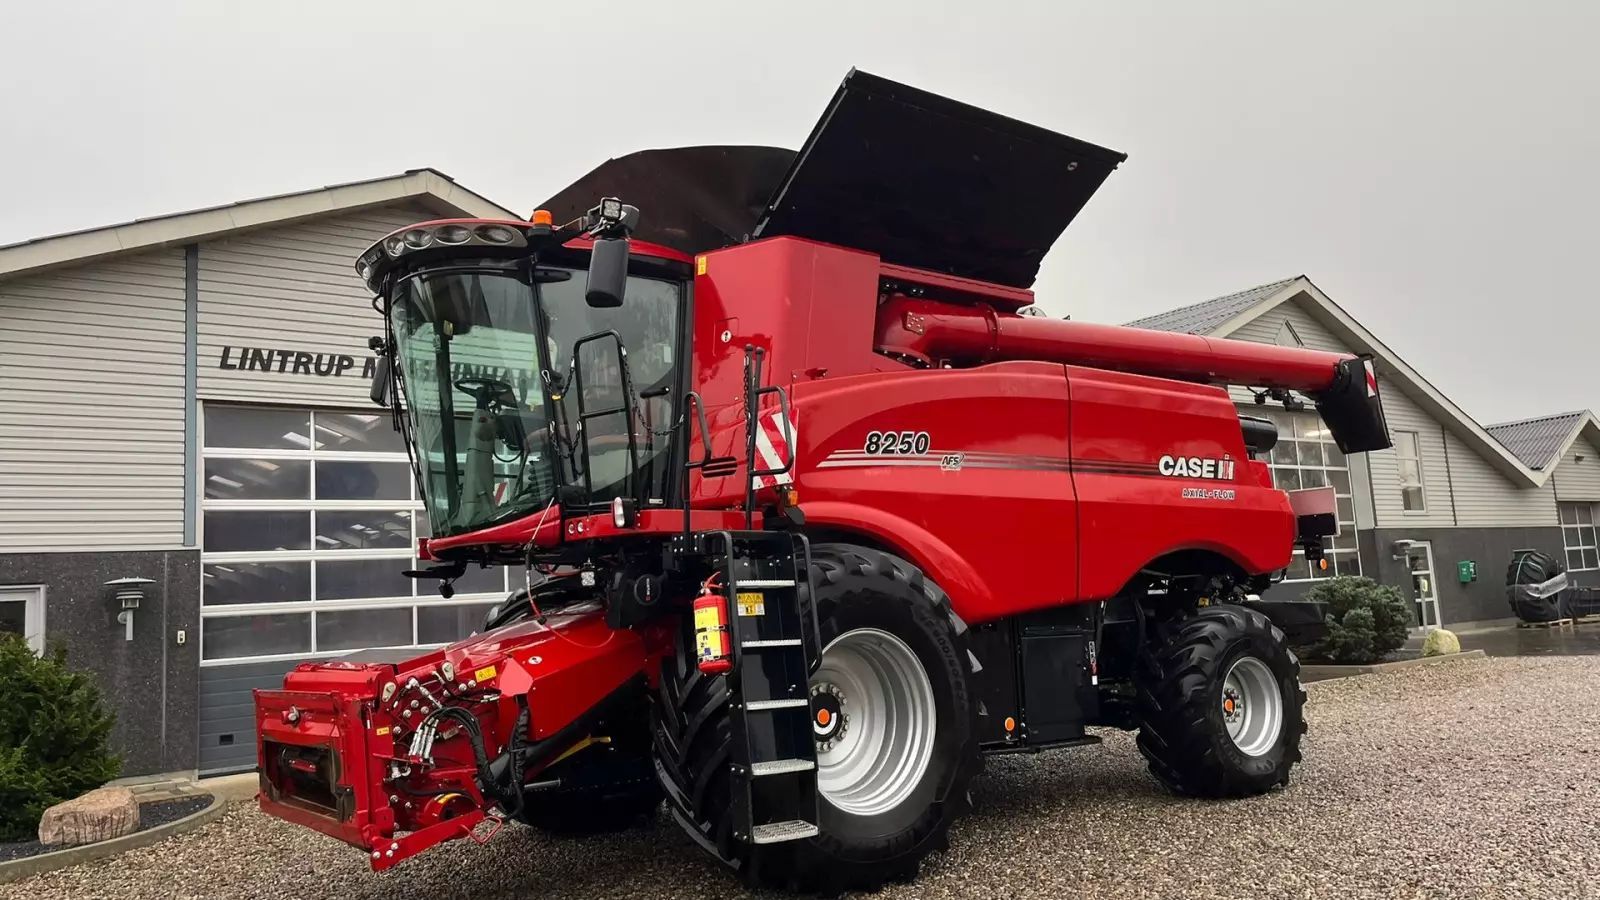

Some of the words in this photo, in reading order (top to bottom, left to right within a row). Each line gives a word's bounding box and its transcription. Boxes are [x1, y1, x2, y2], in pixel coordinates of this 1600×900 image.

[219, 346, 354, 377] LINTRUP
[865, 431, 930, 455] 8250
[941, 454, 961, 466] AFS
[1158, 455, 1215, 479] CASE
[1182, 488, 1235, 500] AXIAL-FLOW
